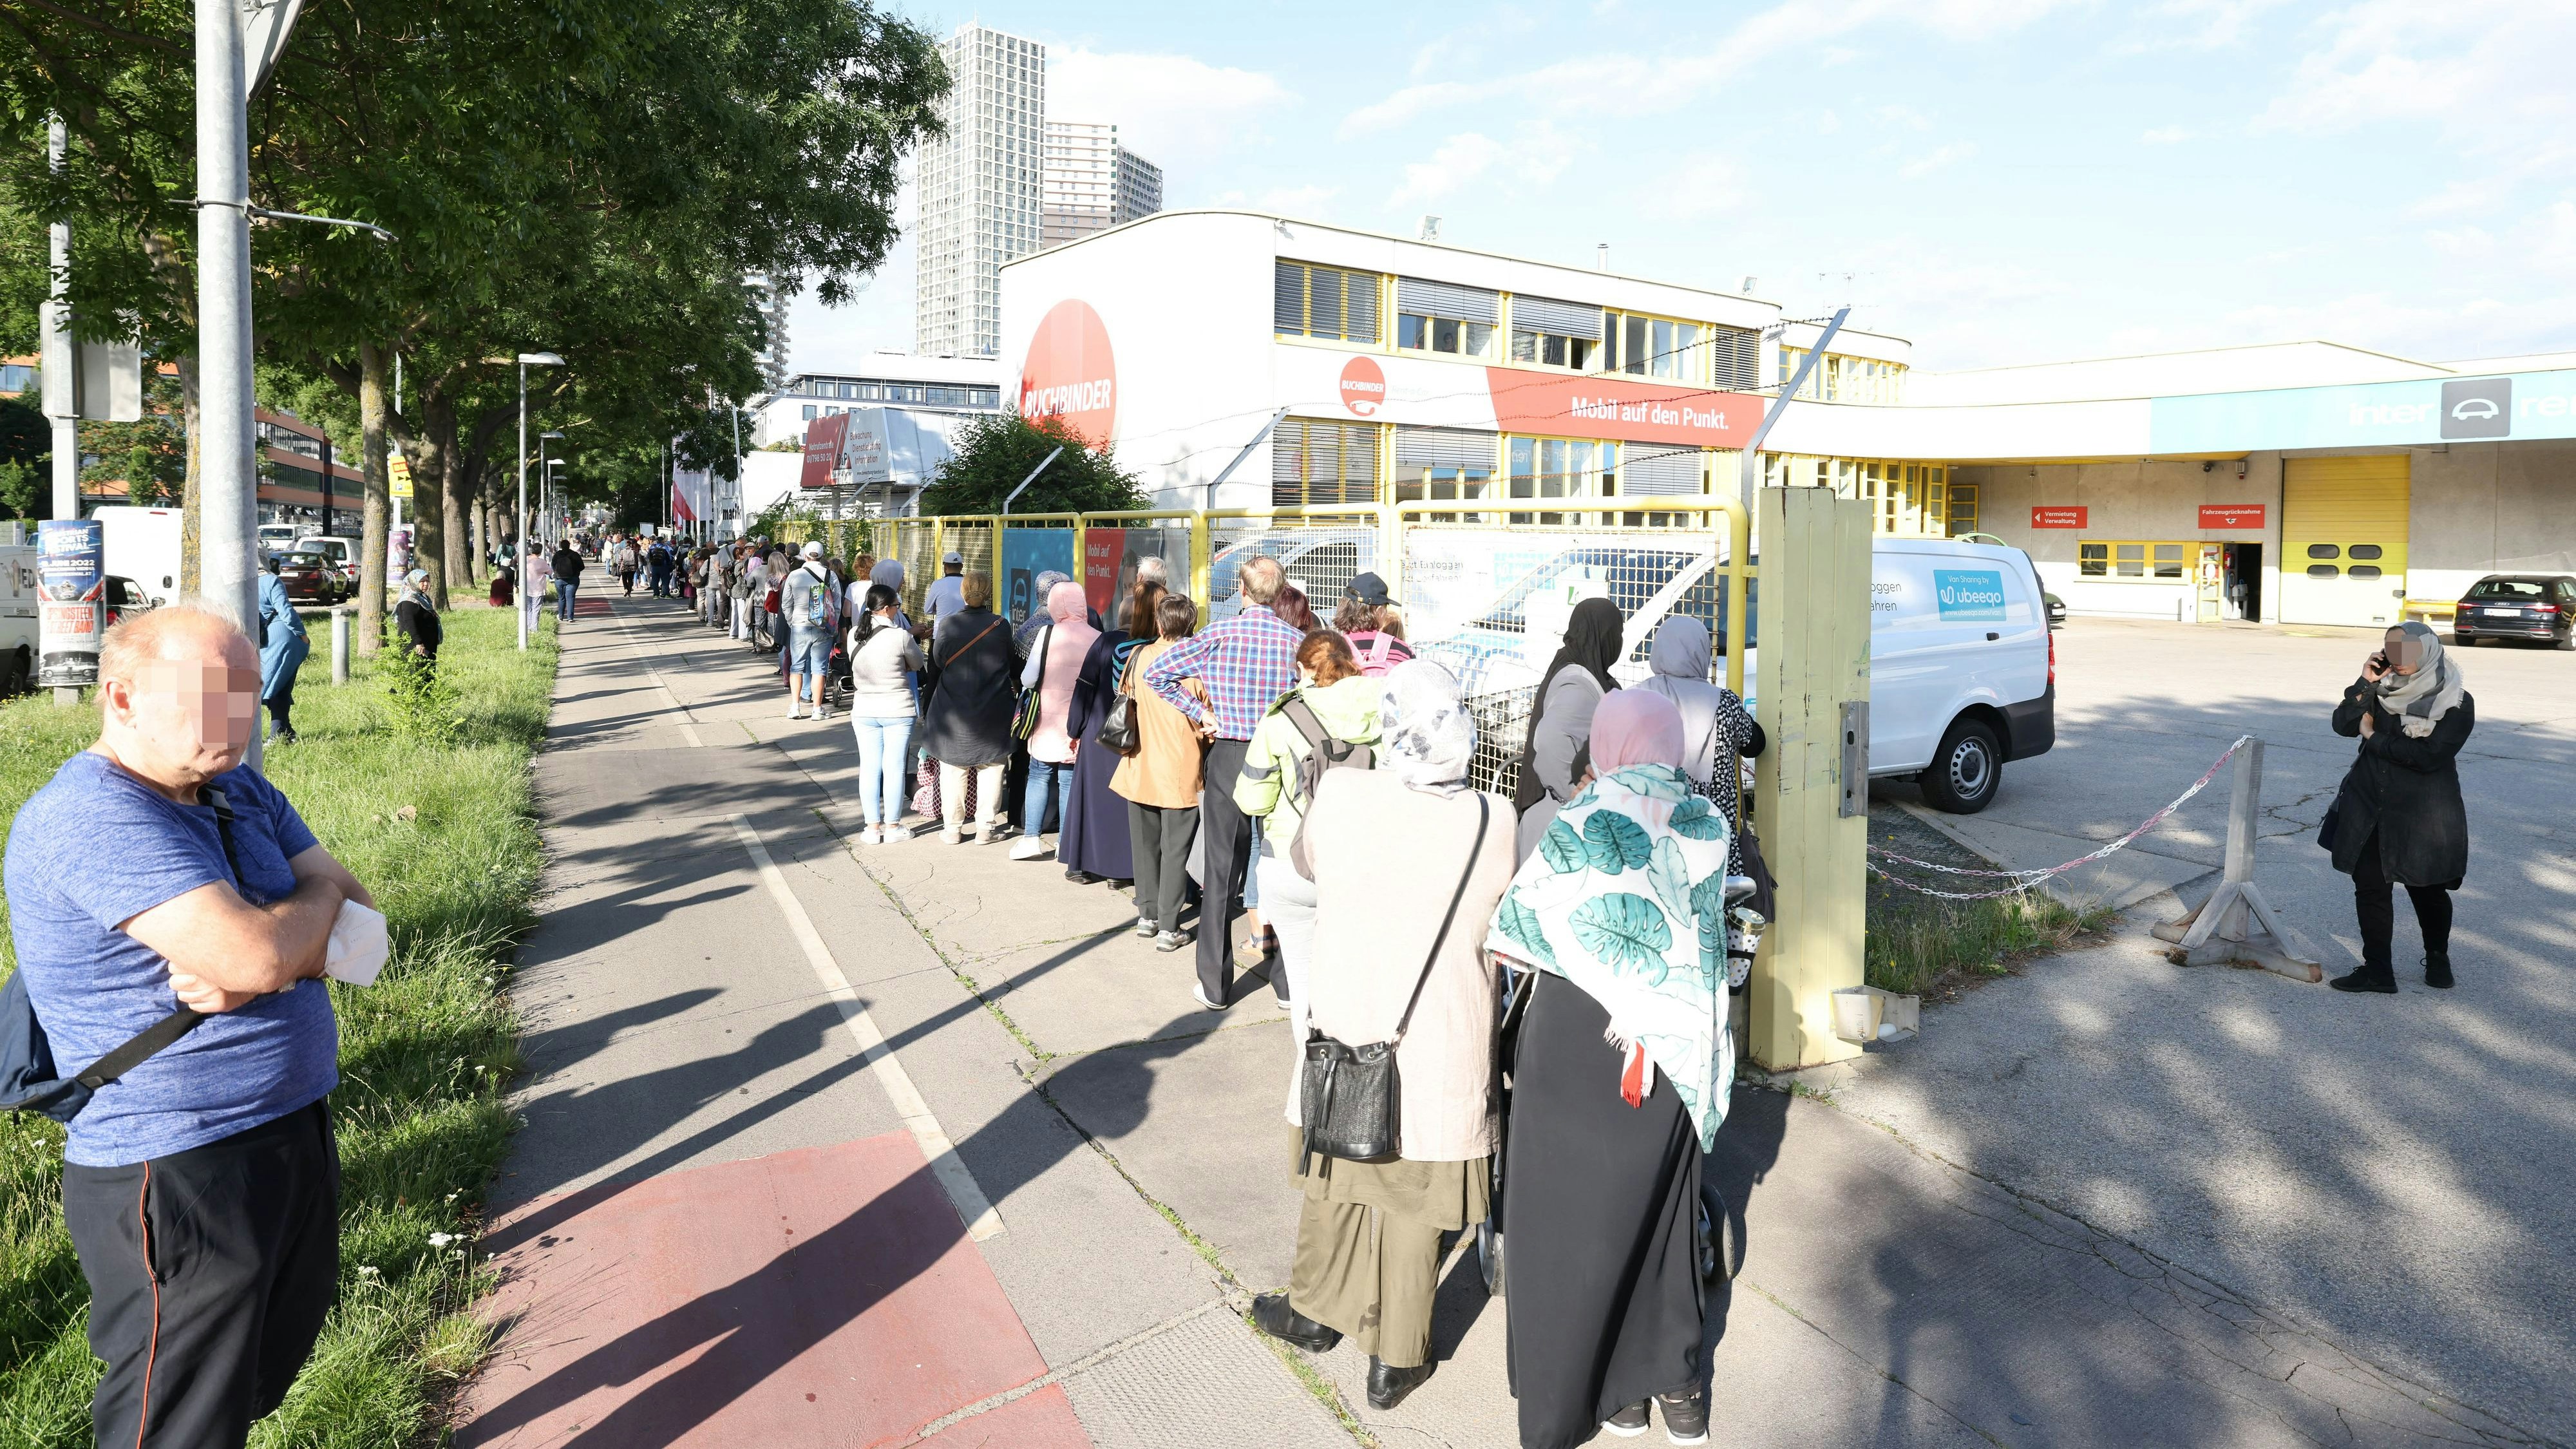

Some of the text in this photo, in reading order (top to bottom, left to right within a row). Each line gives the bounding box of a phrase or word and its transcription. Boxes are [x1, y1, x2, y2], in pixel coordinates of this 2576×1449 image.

[1341, 380, 1385, 393] BUCHBINDER
[1025, 379, 1111, 418] BUCHBINDER
[1572, 396, 1729, 430] Mobil auf den Punkt.
[2349, 402, 2435, 426] inter
[850, 431, 872, 440] Bewachung
[809, 440, 834, 451] Notrufzentrale
[853, 442, 881, 453] Dienstleistung
[820, 453, 825, 462] 50
[826, 452, 831, 461] 20
[855, 454, 878, 464] Information
[723, 503, 741, 520] matik
[1088, 544, 1111, 558] Mobil auf
[1087, 563, 1112, 578] den Punkt.
[1960, 575, 1982, 585] Sharing
[1982, 576, 1989, 585] by
[1871, 583, 1902, 594] oggen
[1957, 587, 2002, 607] ubeeqo
[1870, 600, 1897, 611] ahren
[1012, 604, 1026, 623] inter
[1944, 609, 2001, 618] www.ubeeqo.com/van
